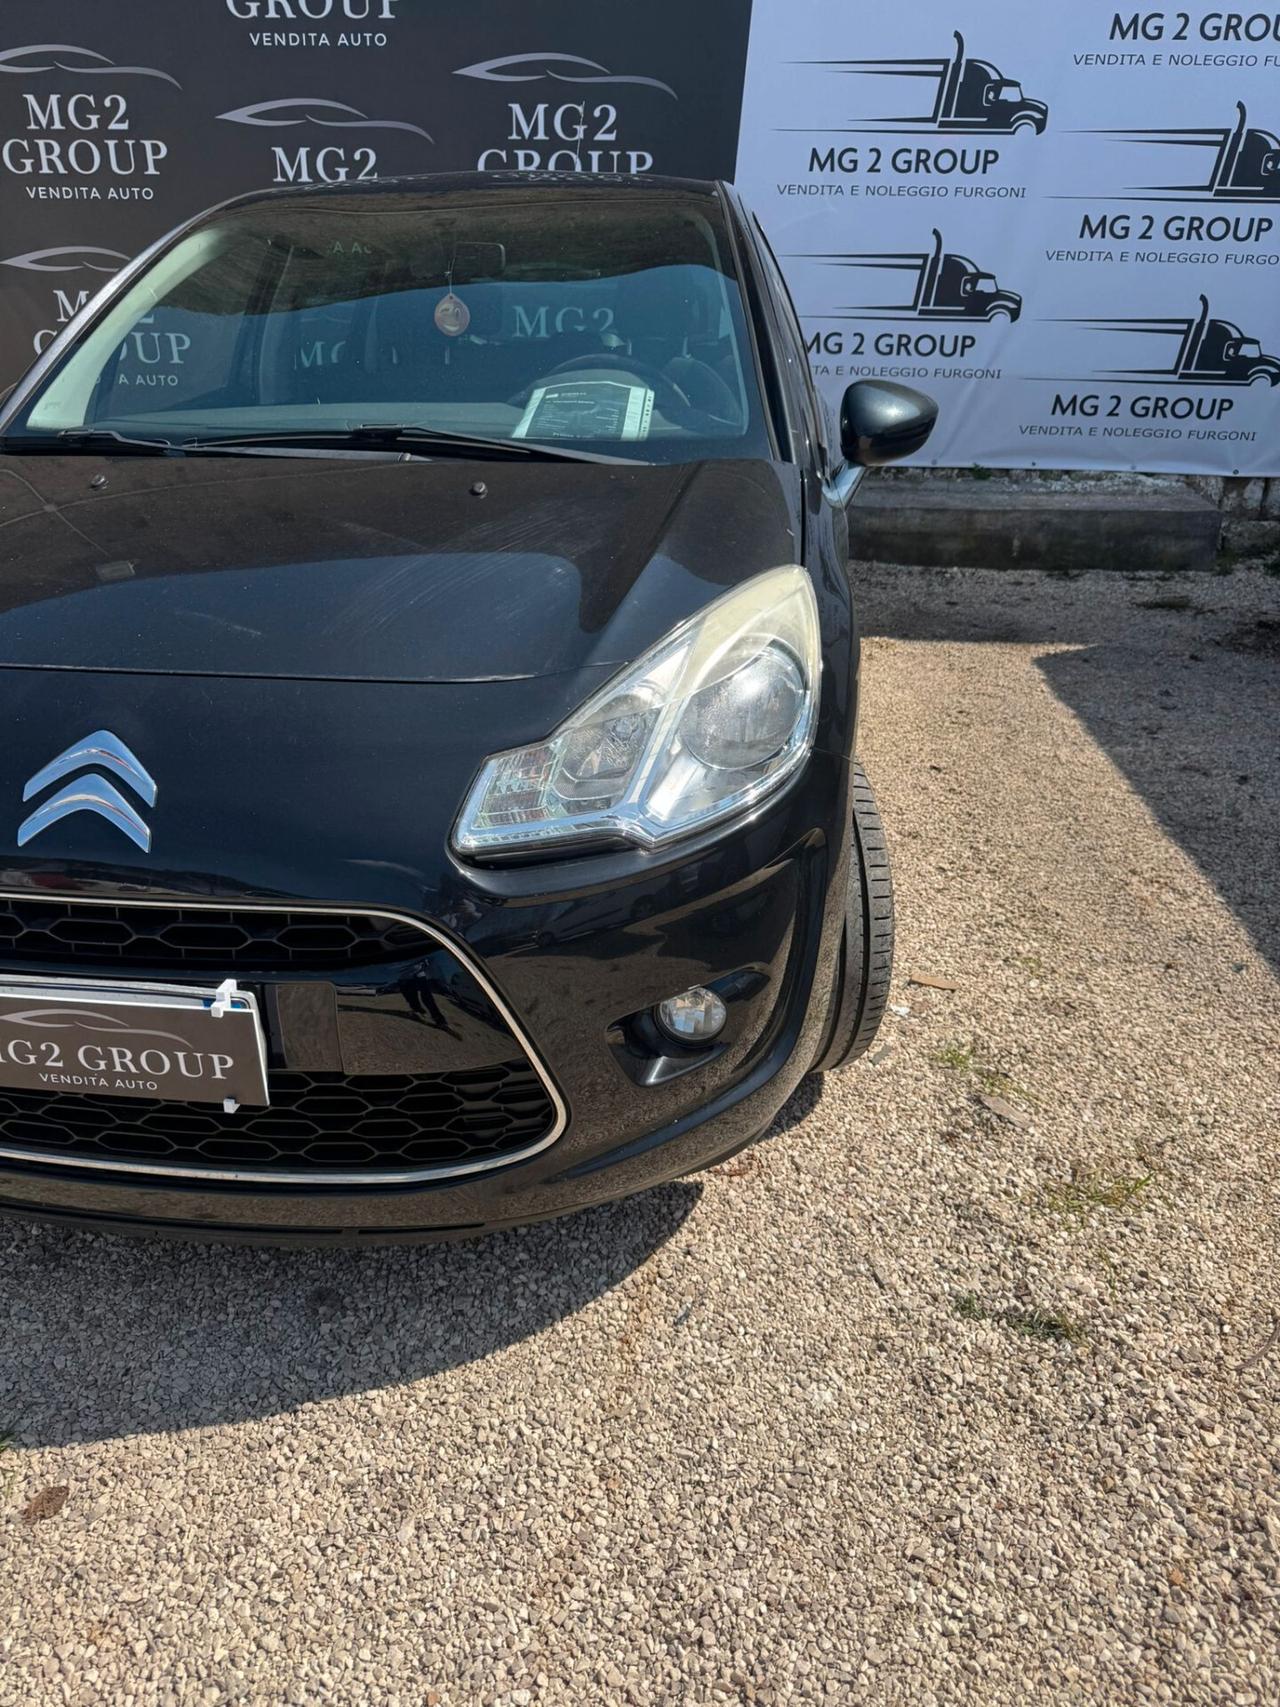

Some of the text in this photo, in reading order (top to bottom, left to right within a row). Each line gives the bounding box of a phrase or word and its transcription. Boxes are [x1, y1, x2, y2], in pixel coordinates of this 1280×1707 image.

[249, 32, 387, 46] VENDITA AUTO
[1109, 12, 1164, 41] MG
[1172, 12, 1190, 41] 2
[1073, 54, 1146, 66] VENDITA
[1152, 54, 1163, 66] E
[1168, 54, 1258, 67] NOLEGGIO
[22, 93, 129, 130] MG2
[508, 103, 617, 141] MG2
[2, 138, 168, 175] GROUP
[271, 146, 378, 183] MG2
[808, 147, 999, 175] MG 2 GROUP
[26, 186, 154, 200] VENDITA AUTO
[776, 184, 1027, 199] VENDITA E NOLEGGIO FURGONI
[1079, 214, 1273, 242] MG 2 GROUP
[1045, 250, 1280, 266] VENDITA E NOLEGGIO FURGO
[851, 332, 865, 356] 2
[874, 332, 976, 358] GROUP
[136, 374, 178, 386] AUTO
[835, 366, 844, 376] E
[850, 366, 929, 378] NOLEGGIO
[934, 368, 1002, 380] FURGONI
[1051, 394, 1234, 420] MG 2 GROUP
[1019, 425, 1257, 441] VENDITA E NOLEGGIO FURGONI
[0, 1039, 234, 1080] G2 GROUP
[39, 1072, 158, 1090] VENDITA AUTO
